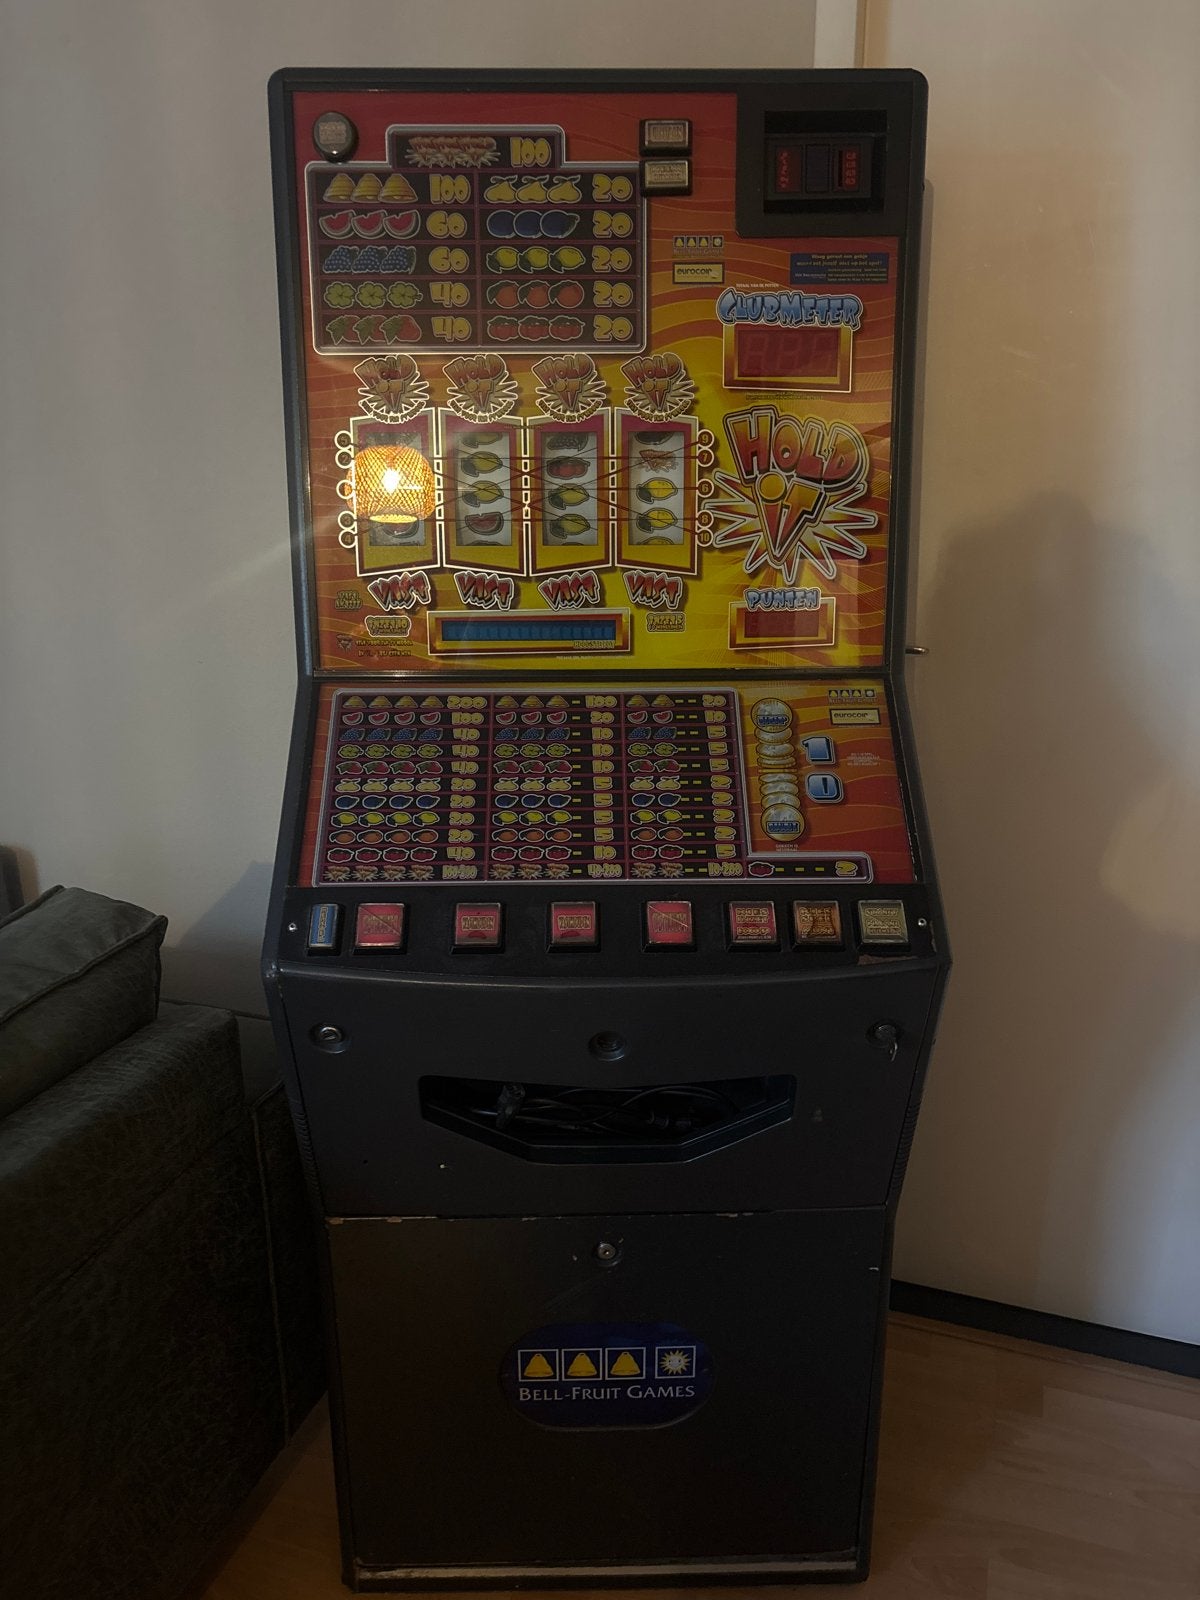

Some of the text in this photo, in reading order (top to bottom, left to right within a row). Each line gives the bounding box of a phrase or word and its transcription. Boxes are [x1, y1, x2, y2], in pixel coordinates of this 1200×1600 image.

[510, 137, 551, 167] 100
[430, 174, 470, 204] 100
[592, 174, 633, 203] 20
[426, 211, 467, 238] 60
[592, 210, 633, 238] 20
[428, 246, 469, 273] 60
[592, 245, 633, 273] 20
[429, 281, 470, 308] 40
[592, 281, 633, 307] 20
[717, 288, 862, 330] CLUBMETER
[429, 316, 471, 342] 40
[592, 314, 633, 341] 20
[353, 354, 418, 387] HOLD
[443, 353, 507, 388] HOLD
[532, 353, 595, 387] HOLD
[621, 352, 685, 387] HOLD
[724, 405, 869, 488] HOLD
[756, 471, 827, 568] IT
[368, 571, 431, 611] VAST
[454, 571, 514, 611] VAST
[538, 571, 600, 611] VAST
[623, 571, 683, 609] VAST
[744, 587, 821, 611] PUNTEN
[447, 696, 487, 708] 200
[585, 695, 617, 707] 100
[702, 695, 726, 707] 20
[451, 711, 484, 725] 100
[590, 711, 614, 723] 20
[705, 710, 726, 723] 10
[453, 728, 480, 741] 40
[592, 727, 614, 740] 10
[452, 744, 479, 757] 40
[592, 743, 614, 756] 10
[451, 761, 479, 774] 40
[592, 760, 614, 773] 10
[450, 778, 476, 791] 20
[450, 795, 475, 808] 20
[449, 811, 474, 825] 20
[448, 829, 474, 843] 20
[447, 846, 475, 861] 40
[594, 845, 616, 860] 10
[519, 1384, 696, 1401] BELL-FRUIT GAMES
